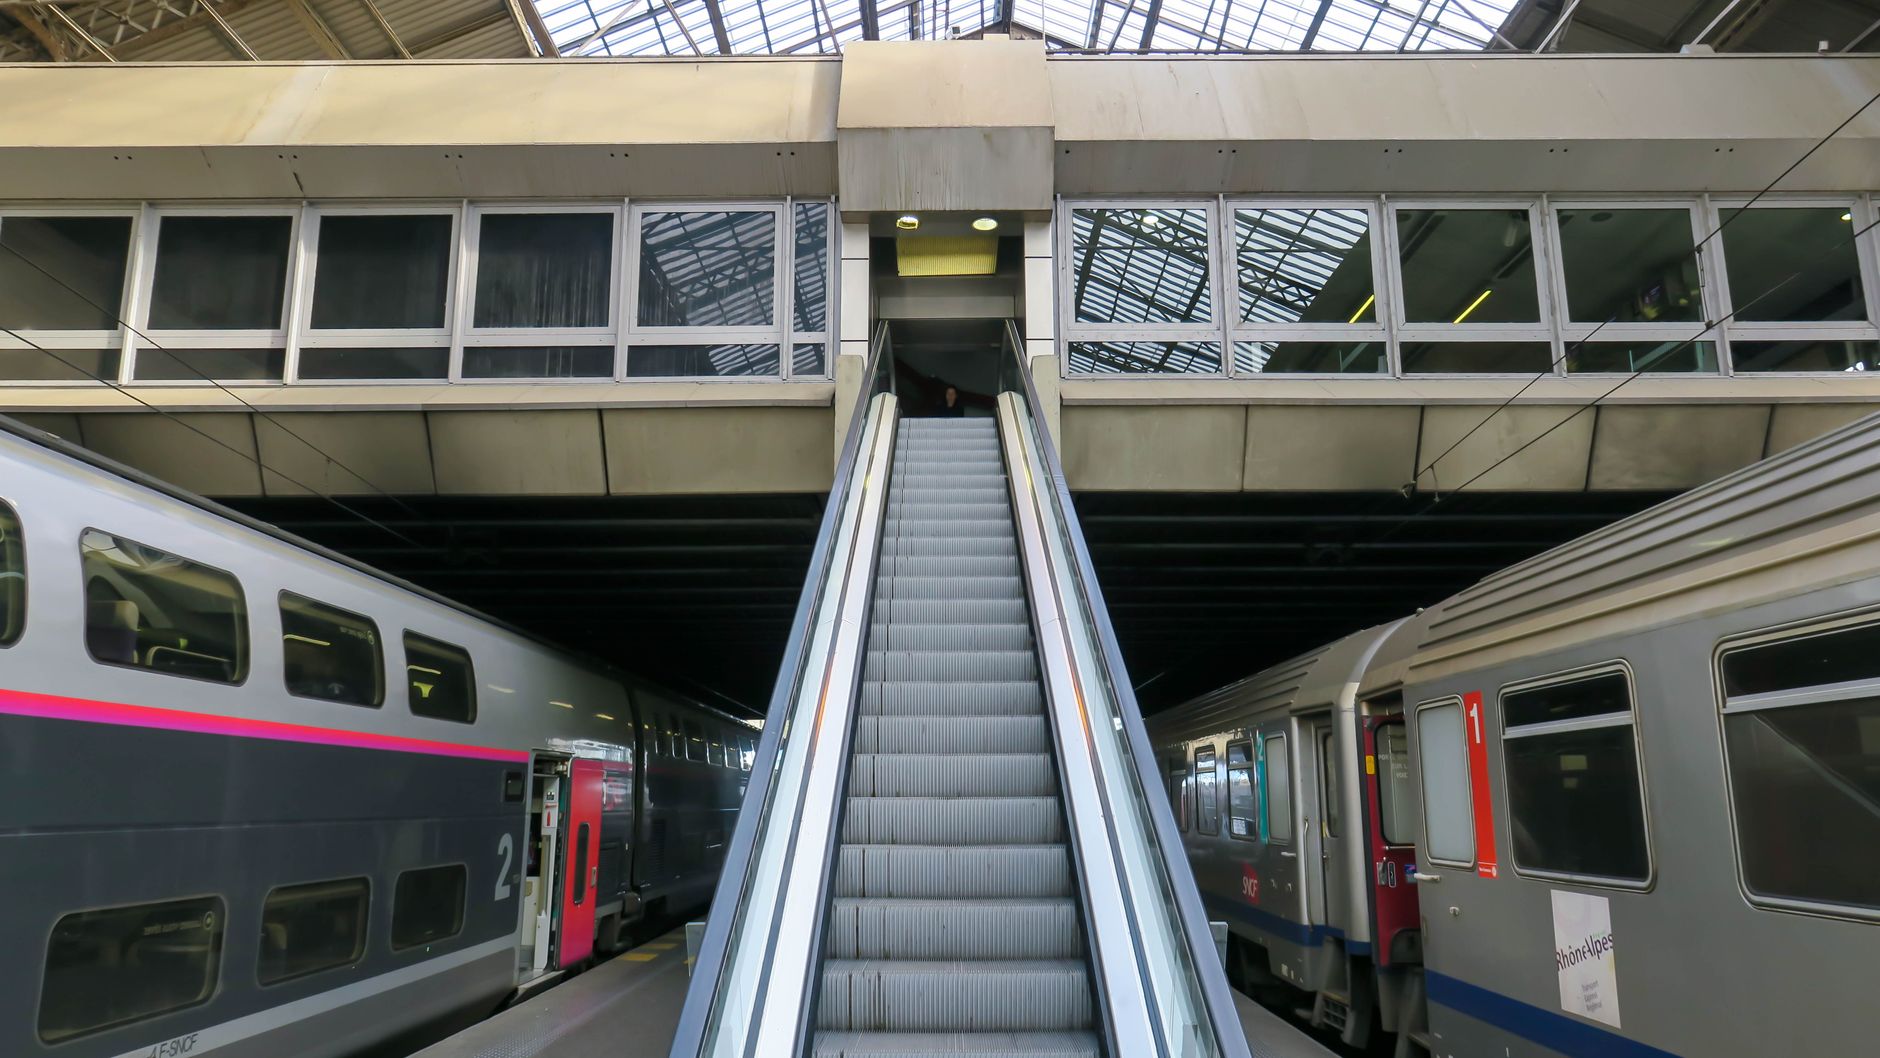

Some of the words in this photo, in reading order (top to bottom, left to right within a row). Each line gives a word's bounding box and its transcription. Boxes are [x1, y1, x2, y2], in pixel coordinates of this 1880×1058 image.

[1469, 703, 1481, 744] 1
[494, 833, 514, 901] 2
[1242, 876, 1258, 898] SNCF
